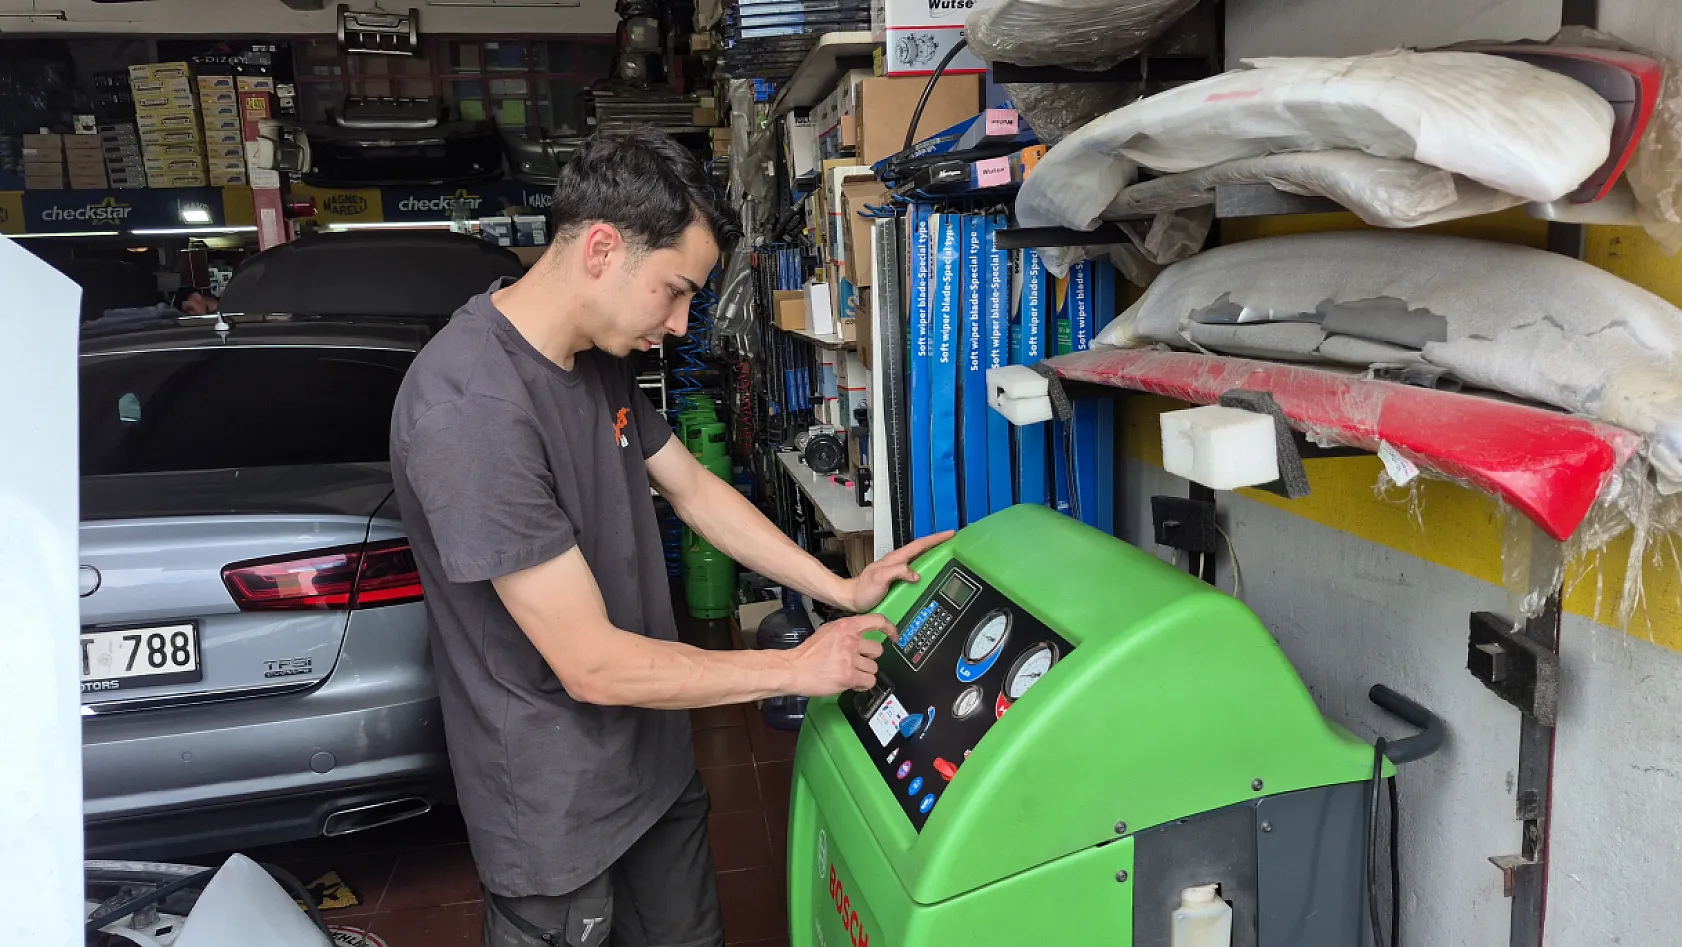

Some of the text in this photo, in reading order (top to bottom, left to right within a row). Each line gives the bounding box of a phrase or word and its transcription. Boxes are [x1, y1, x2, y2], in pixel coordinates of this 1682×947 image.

[41, 204, 132, 221] checkstar
[399, 195, 482, 211] checkar
[917, 221, 928, 356] Soft wiper blade-Special type
[941, 247, 953, 312] blade-Special
[990, 253, 1001, 319] blade-Special
[969, 231, 980, 371] Soft wiper blade-Special type
[1028, 250, 1041, 356] Soft wiper blade-Speci
[1076, 301, 1089, 330] wiper
[939, 315, 952, 341] wiper
[990, 321, 1001, 349] wiper
[1076, 331, 1086, 349] Soft
[939, 343, 949, 364] Soft
[991, 350, 1000, 369] Soft
[122, 630, 190, 672] 788
[829, 862, 869, 947] BOSCH
